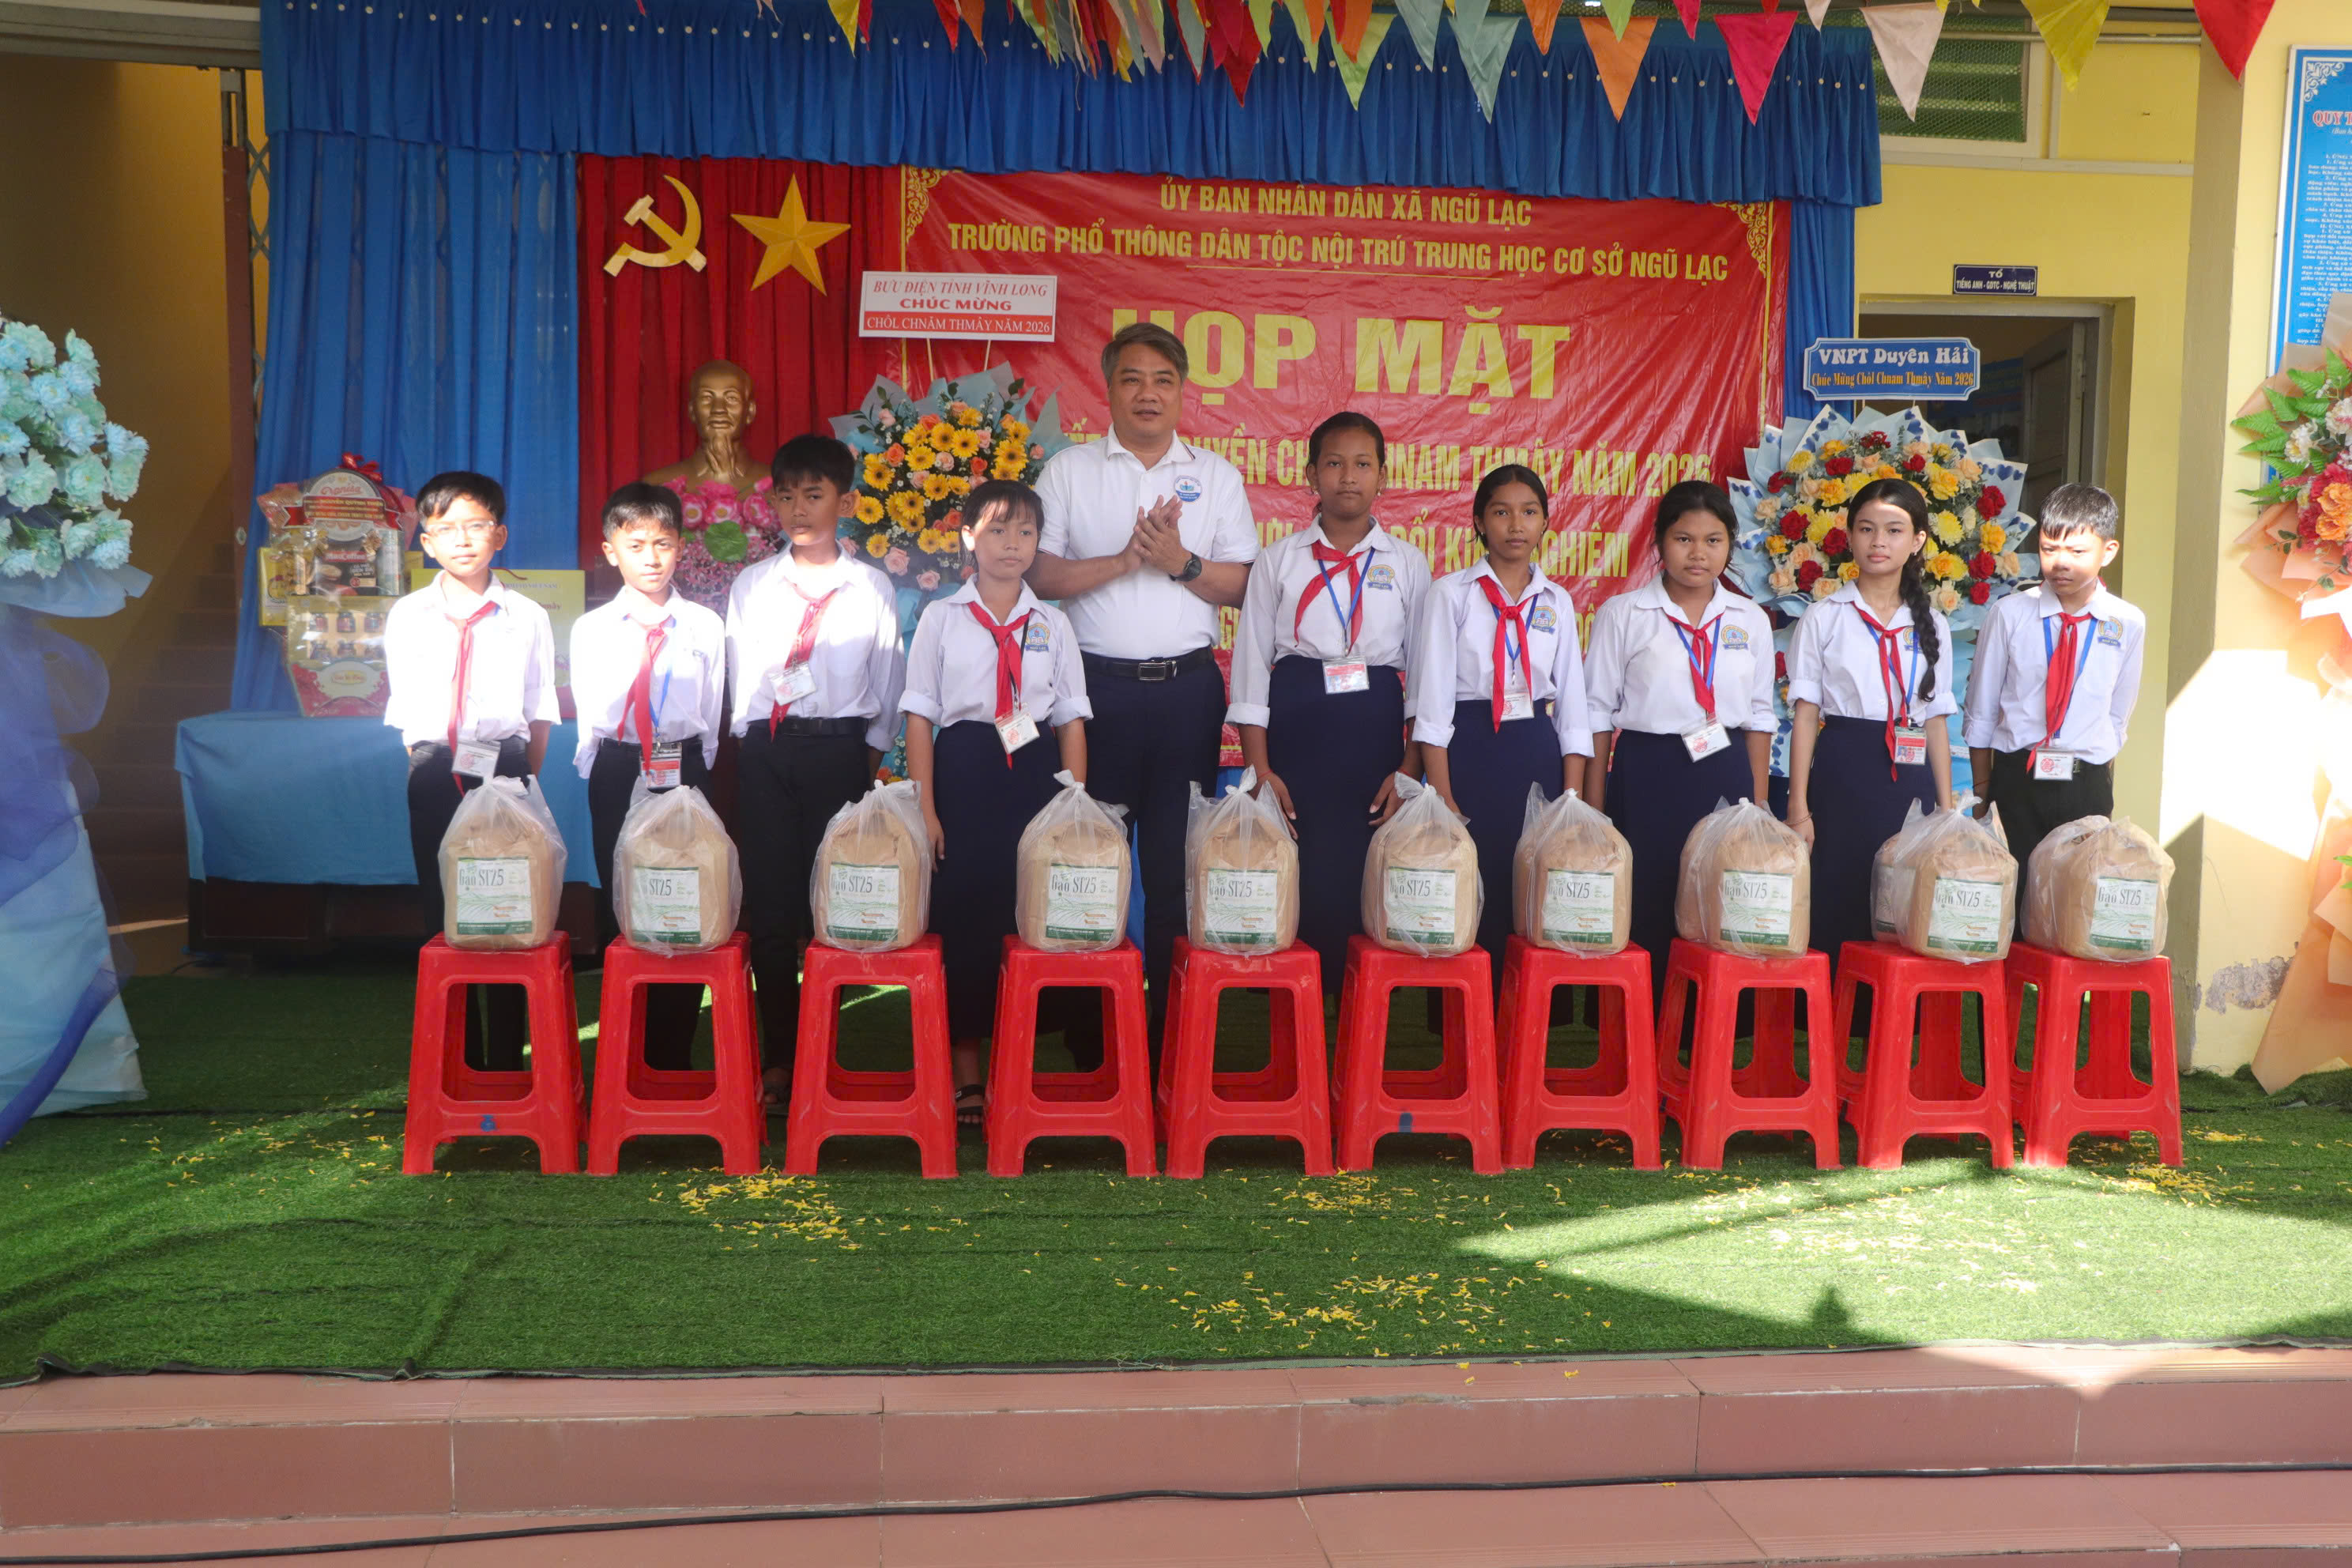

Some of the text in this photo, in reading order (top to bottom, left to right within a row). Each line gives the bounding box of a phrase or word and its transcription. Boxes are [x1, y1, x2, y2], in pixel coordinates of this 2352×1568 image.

[2312, 110, 2343, 127] QUY
[1160, 175, 1532, 232] ỦY BAN NHÂN DÂN XÃ NGŨ LẠC
[948, 217, 1728, 286] TRƯỜNG PHỔ THÔNG DÂN TỘC NỘI TRÚ TRUNG HỌC CƠ SỞ NGŨ LẠC
[976, 280, 1008, 295] VĨNH
[1011, 283, 1048, 297] LONG
[899, 296, 1012, 311] CHÚC MỪNG
[996, 318, 1023, 332] NĂM
[1025, 321, 1050, 333] 2026
[1112, 305, 1571, 416] ỌP MẶT
[1819, 347, 1969, 367] VNPT Duyên Hải
[1954, 372, 1973, 386] 2026
[1573, 440, 1637, 496] NĂM
[1529, 521, 1630, 588] GHIỆM
[478, 869, 505, 887] ST25
[649, 878, 673, 896] ST25
[848, 875, 873, 893] ST25
[1072, 875, 1097, 894] ST25
[1227, 880, 1253, 898] ST25
[1407, 879, 1431, 897] ST25
[1566, 882, 1590, 899] ST25
[1743, 882, 1768, 899] ST25
[2119, 888, 2141, 906] ST25
[1956, 889, 1981, 907] ST25
